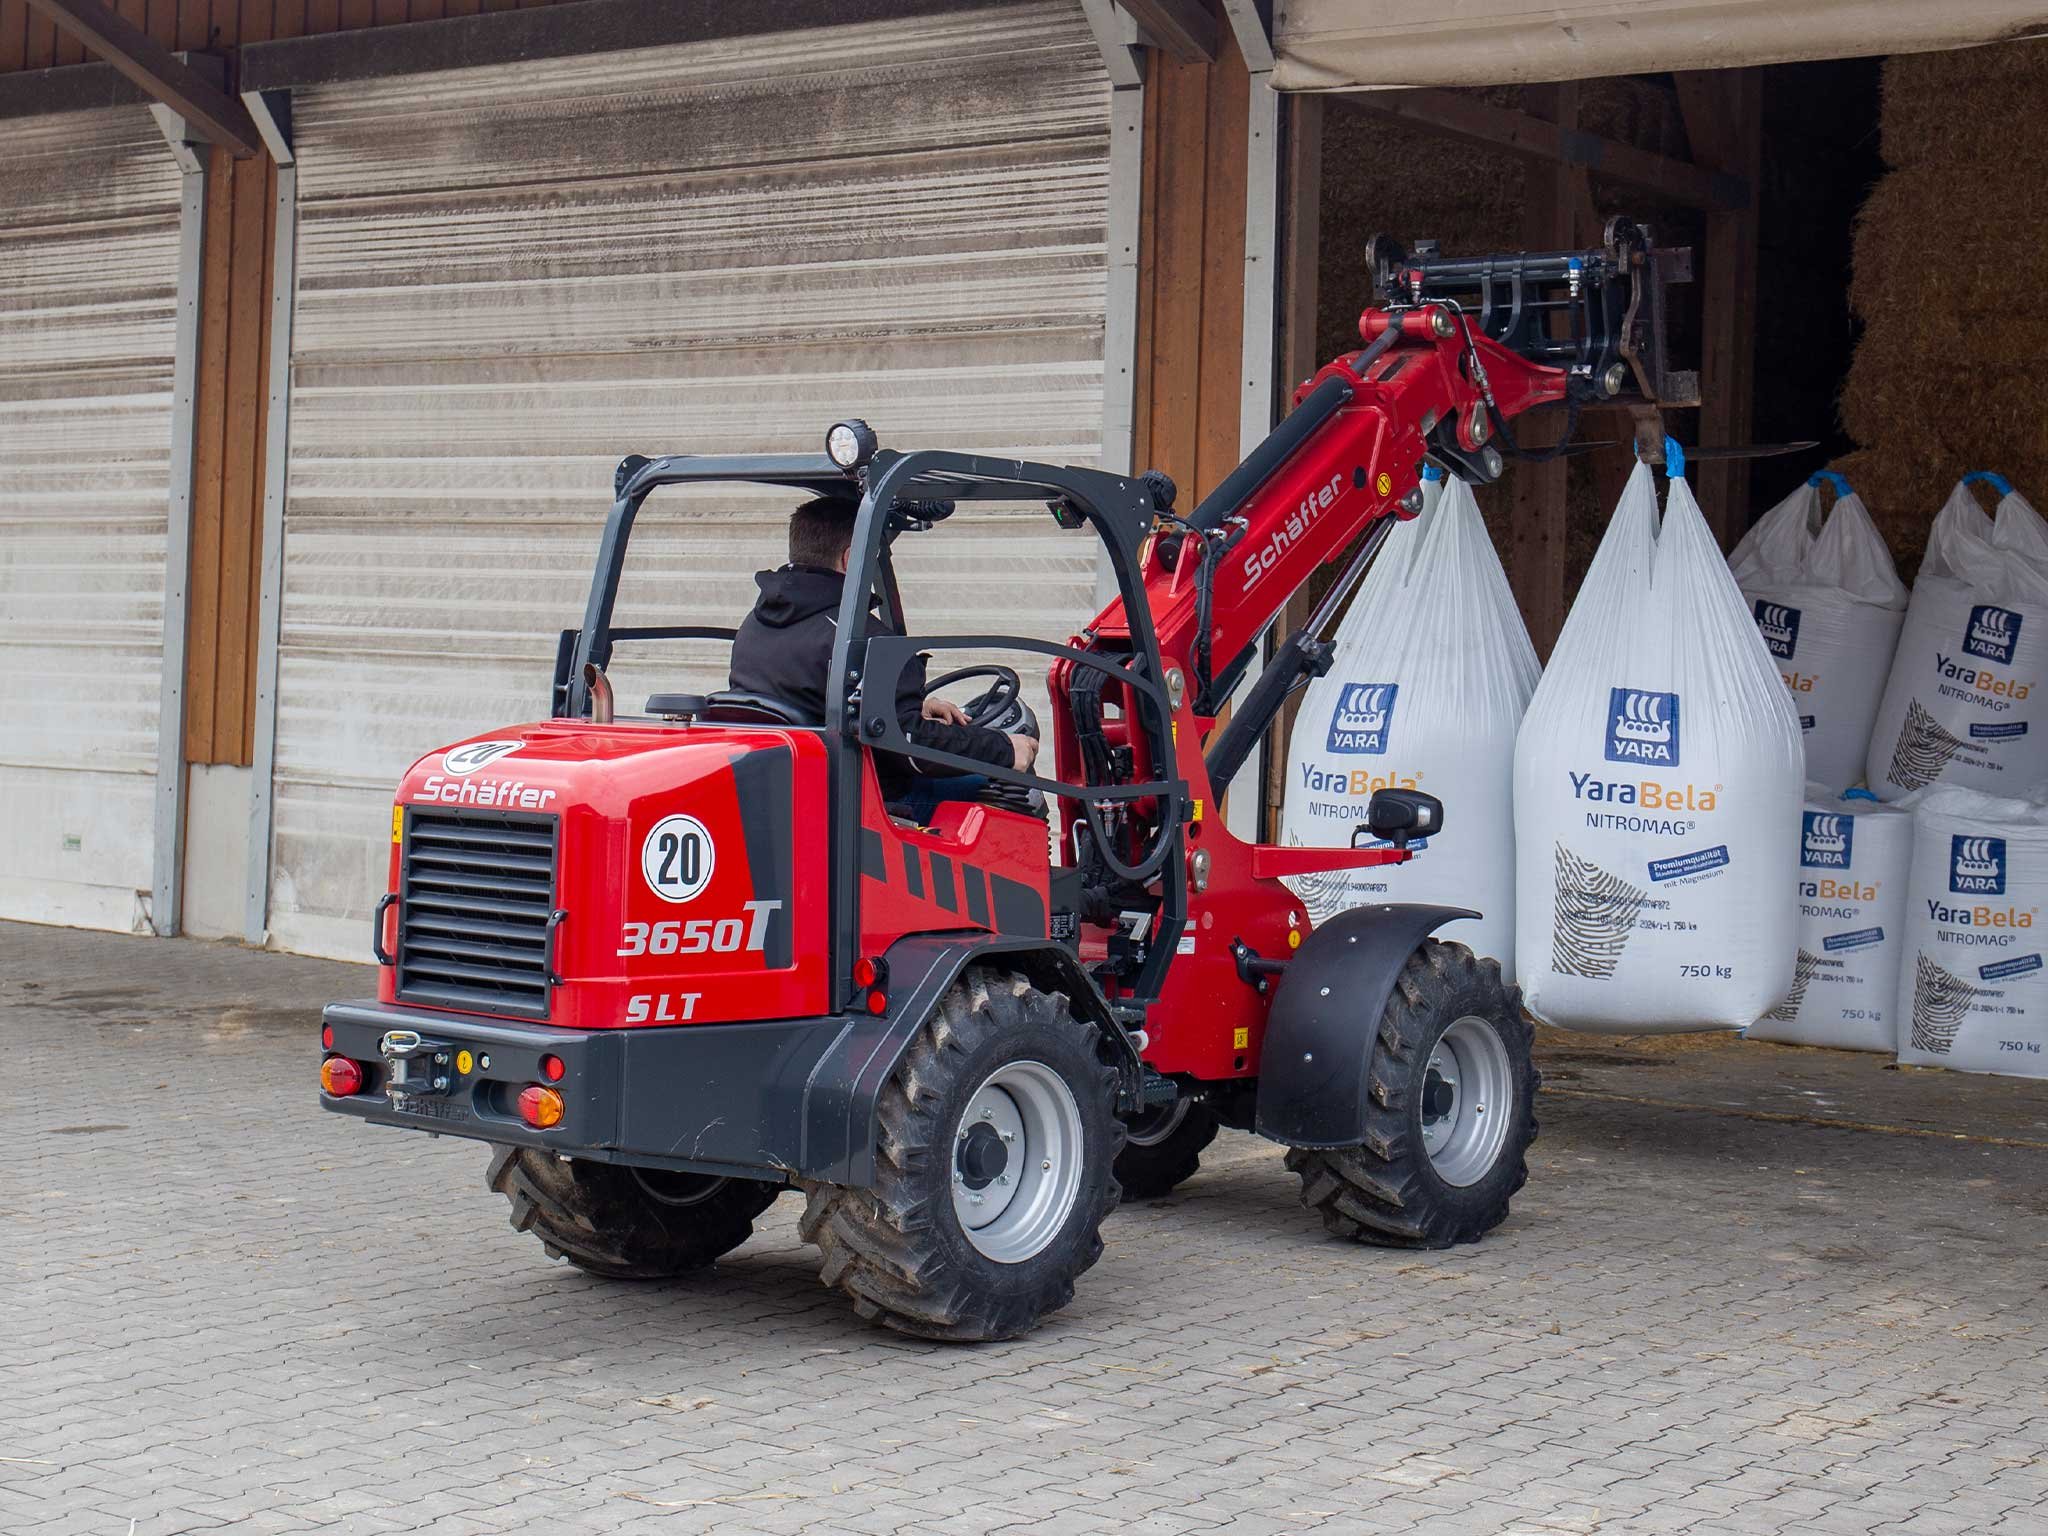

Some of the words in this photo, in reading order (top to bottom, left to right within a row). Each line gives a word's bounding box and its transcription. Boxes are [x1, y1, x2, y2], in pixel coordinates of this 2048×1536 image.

[1242, 473, 1342, 592] Schäffer
[1766, 638, 1788, 655] RA
[1968, 639, 2007, 659] YARA
[1333, 733, 1380, 748] YARA
[1614, 740, 1671, 760] YARA
[451, 743, 516, 764] 20
[413, 776, 556, 809] Schäffer
[1308, 802, 1371, 820] NITROM
[1586, 812, 1696, 835] NITROMAG®
[658, 832, 701, 886] 20
[1804, 850, 1844, 865] YARA
[1798, 879, 1882, 902] raBela®
[1955, 876, 1998, 891] YARA
[617, 900, 782, 957] 3650T
[1937, 930, 2017, 947] NITROMAG®
[1679, 965, 1711, 977] 750
[1716, 965, 1732, 979] kg
[626, 993, 702, 1023] SLT
[1841, 1008, 1864, 1019] 750
[1869, 1009, 1881, 1021] kg
[1999, 1041, 2023, 1051] 750
[2027, 1041, 2040, 1053] kg
